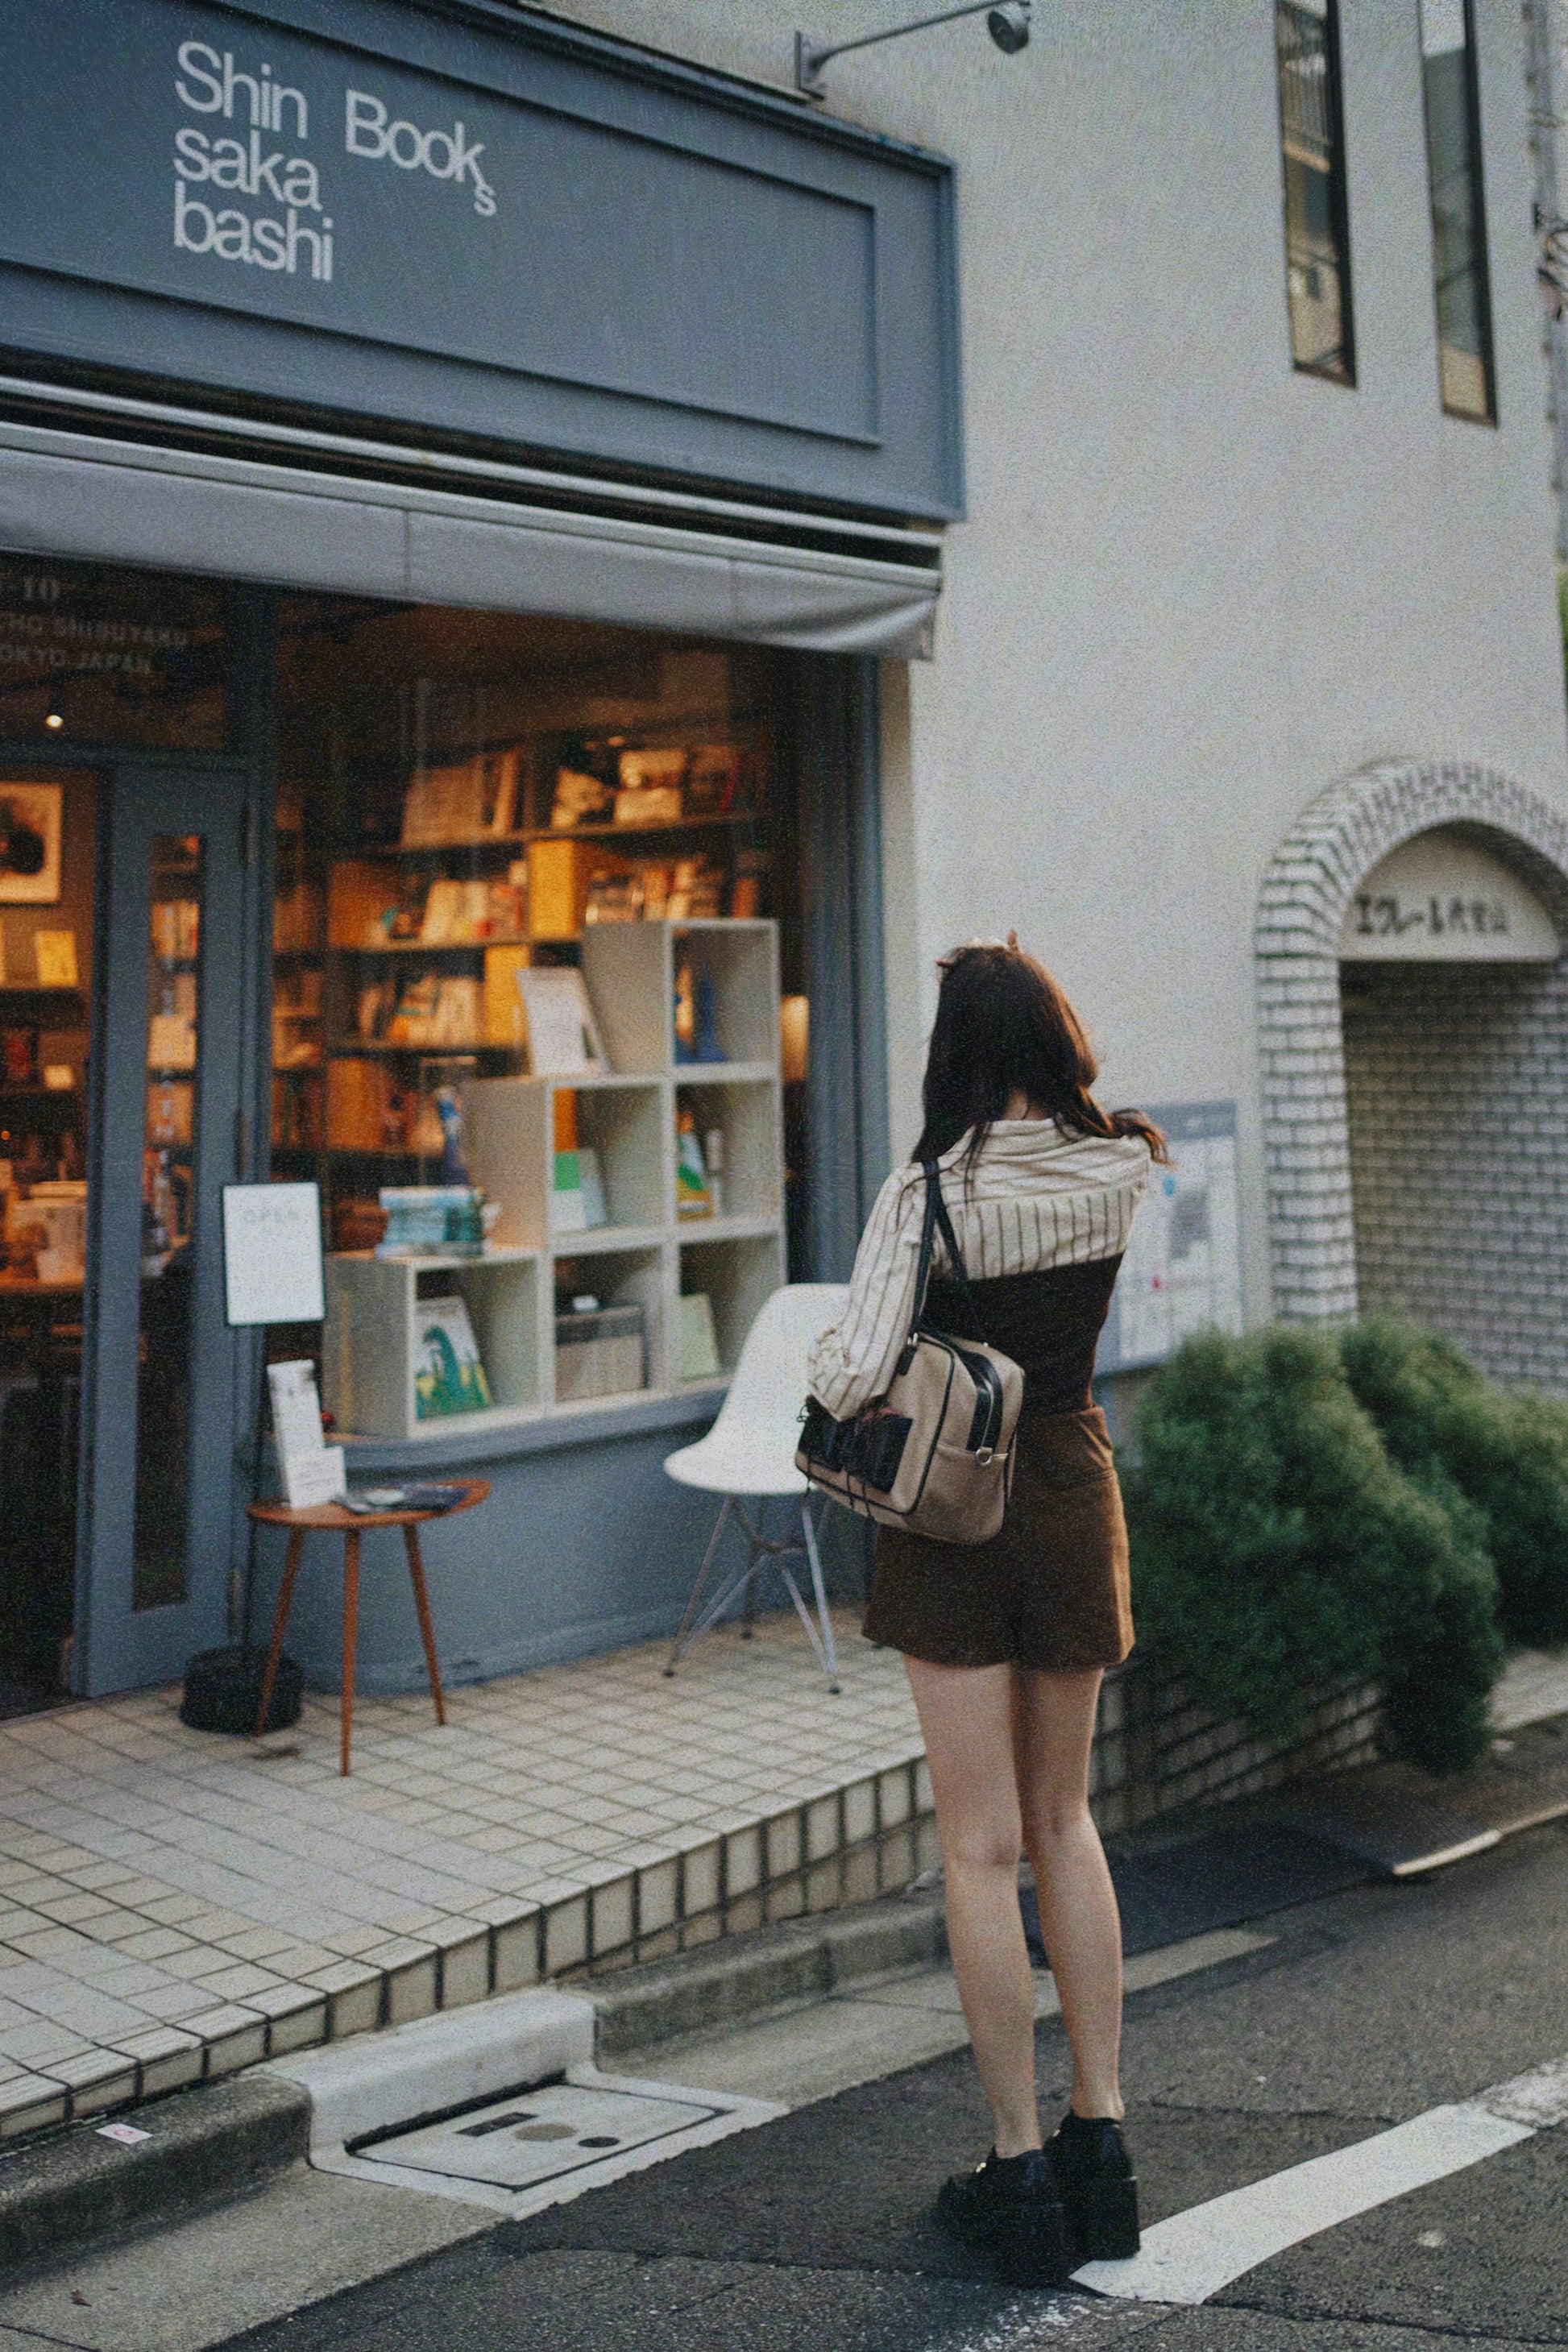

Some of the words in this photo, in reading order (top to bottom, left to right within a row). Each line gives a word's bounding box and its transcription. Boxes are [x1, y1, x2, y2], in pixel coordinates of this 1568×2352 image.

[174, 128, 322, 211] saka
[176, 41, 308, 139] Shin
[345, 89, 498, 217] Books
[174, 180, 334, 282] bashi
[77, 650, 151, 674] JAPAN
